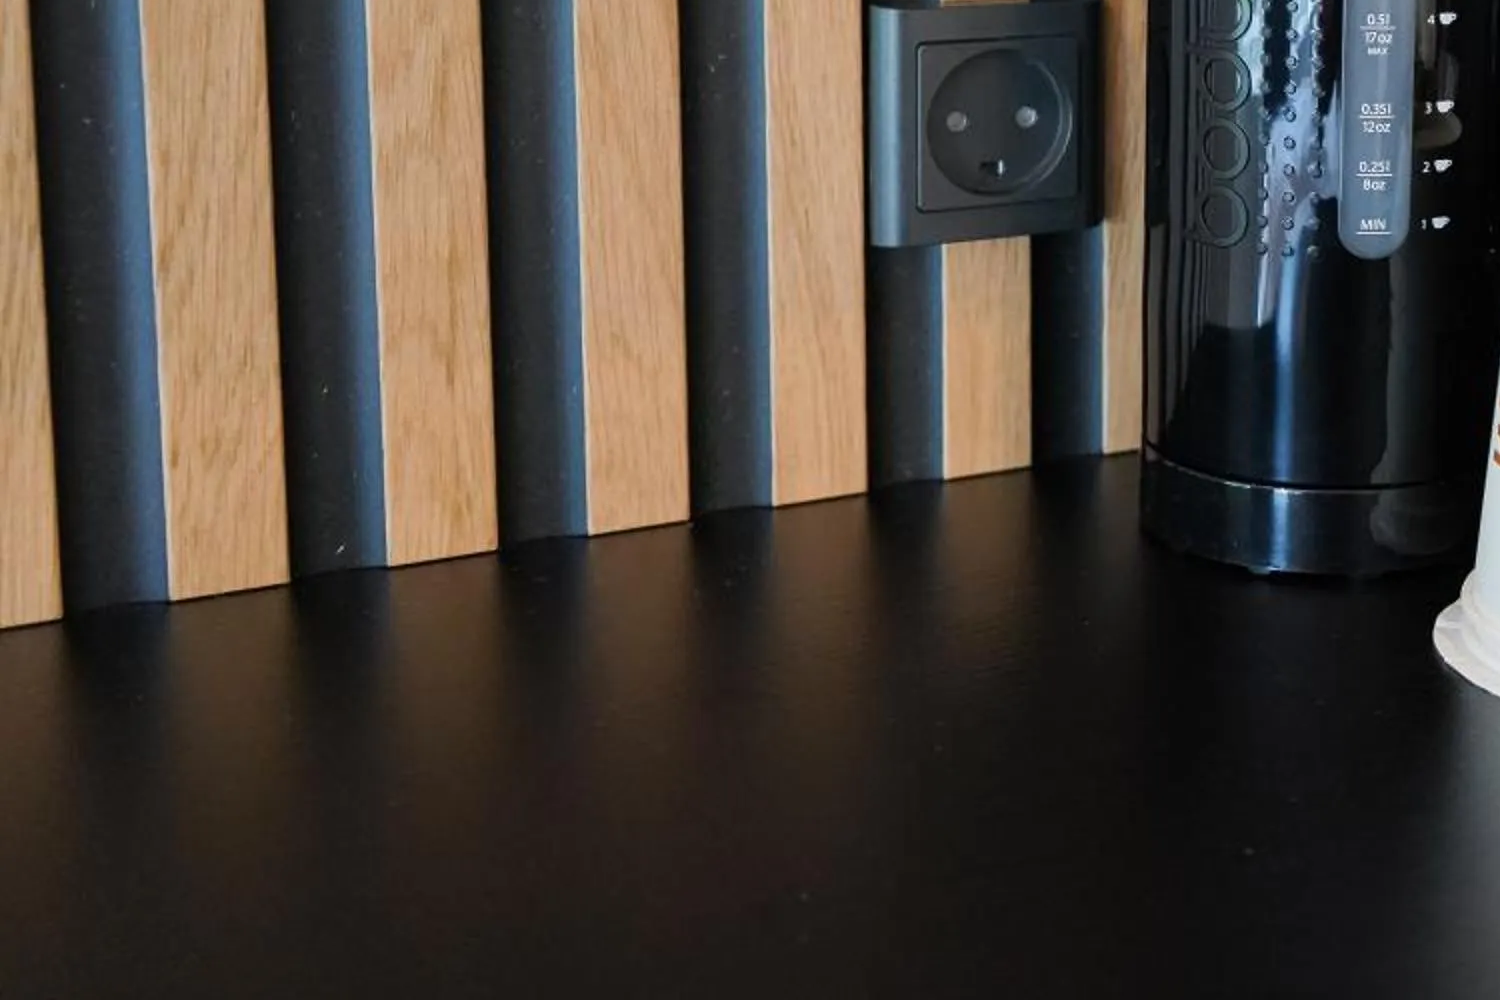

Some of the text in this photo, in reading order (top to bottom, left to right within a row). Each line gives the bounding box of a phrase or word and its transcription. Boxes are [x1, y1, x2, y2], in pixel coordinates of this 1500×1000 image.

[1427, 14, 1435, 25] 4
[1367, 46, 1389, 56] MAX
[1425, 101, 1433, 115] 3
[1422, 160, 1431, 174] 2
[1360, 218, 1387, 231] MIN
